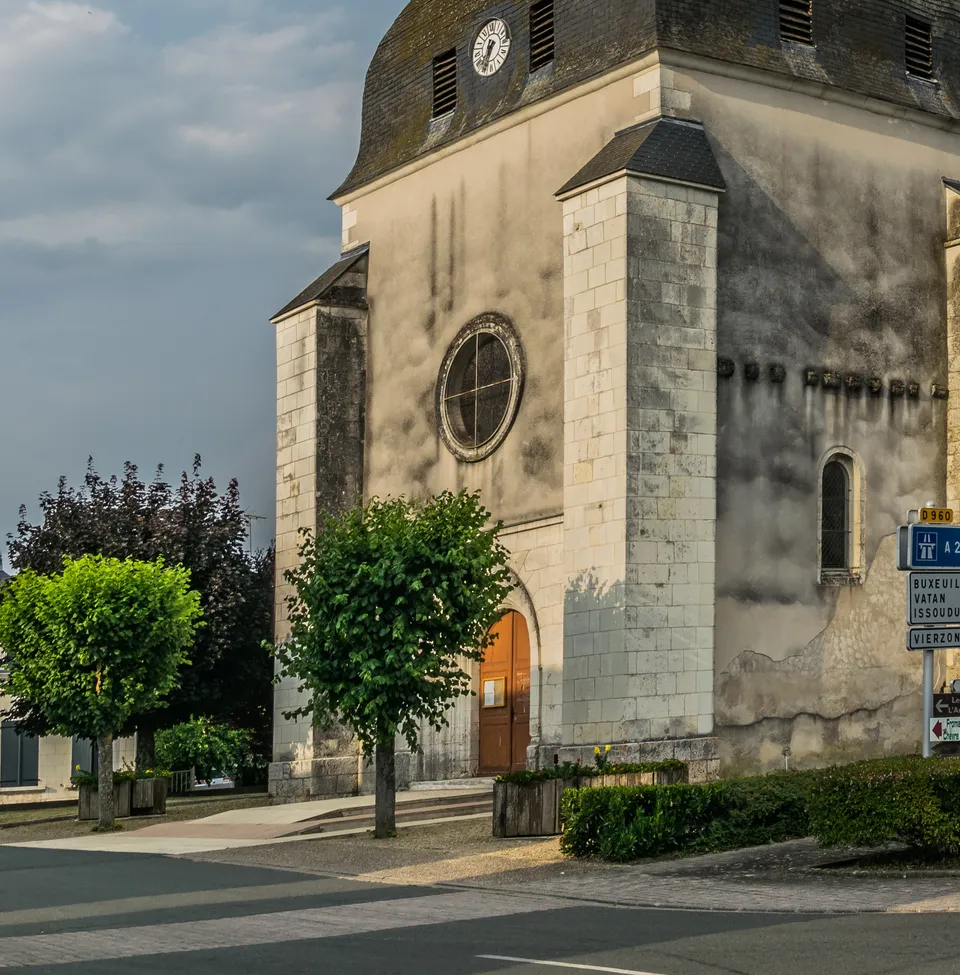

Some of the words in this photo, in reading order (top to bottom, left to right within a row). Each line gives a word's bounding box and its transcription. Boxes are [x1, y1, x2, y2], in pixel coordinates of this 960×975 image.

[922, 511, 928, 520] D
[931, 511, 951, 521] 960
[944, 541, 951, 554] A
[914, 579, 960, 589] BUXEUIL
[914, 593, 946, 604] VATAN
[914, 632, 960, 644] VIERZON
